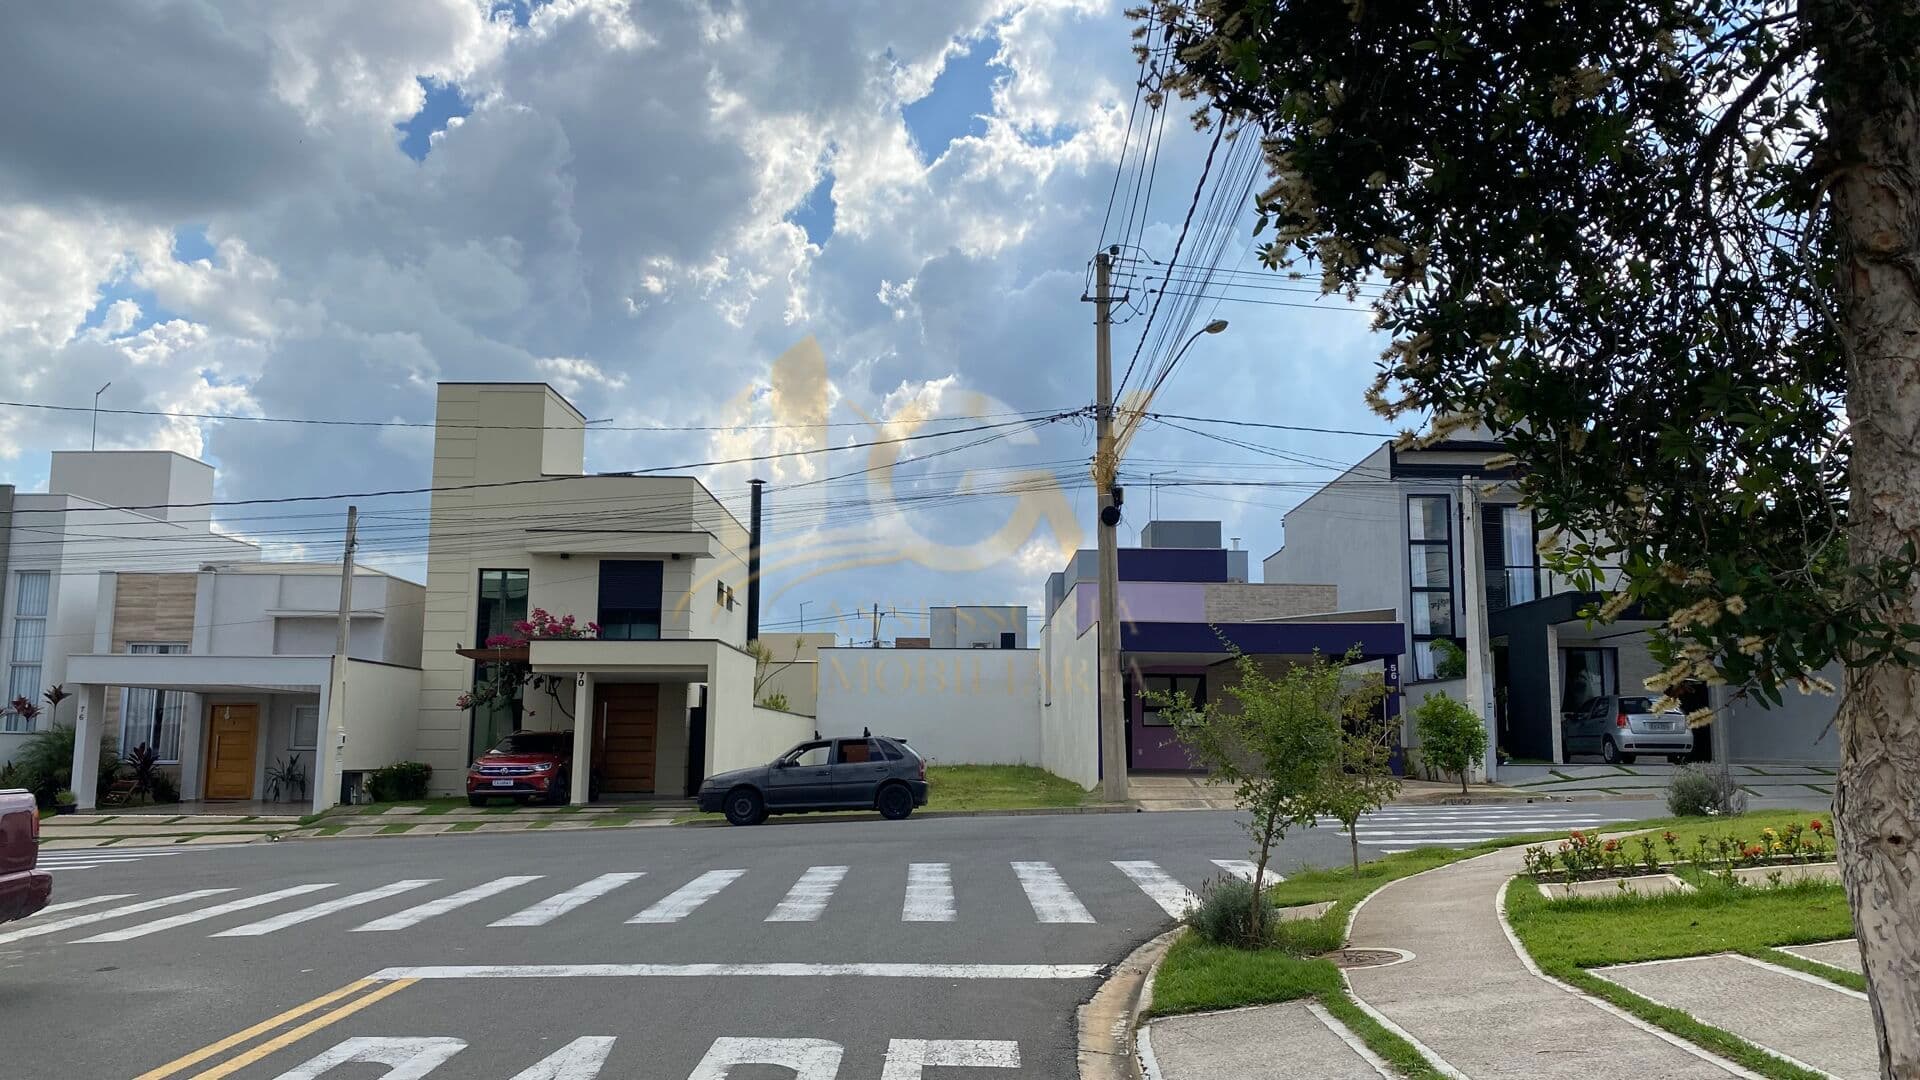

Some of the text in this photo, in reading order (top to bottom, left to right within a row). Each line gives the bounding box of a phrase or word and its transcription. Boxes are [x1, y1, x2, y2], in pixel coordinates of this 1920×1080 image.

[578, 671, 585, 686] 70
[1390, 664, 1397, 680] 56
[79, 705, 86, 721] 76
